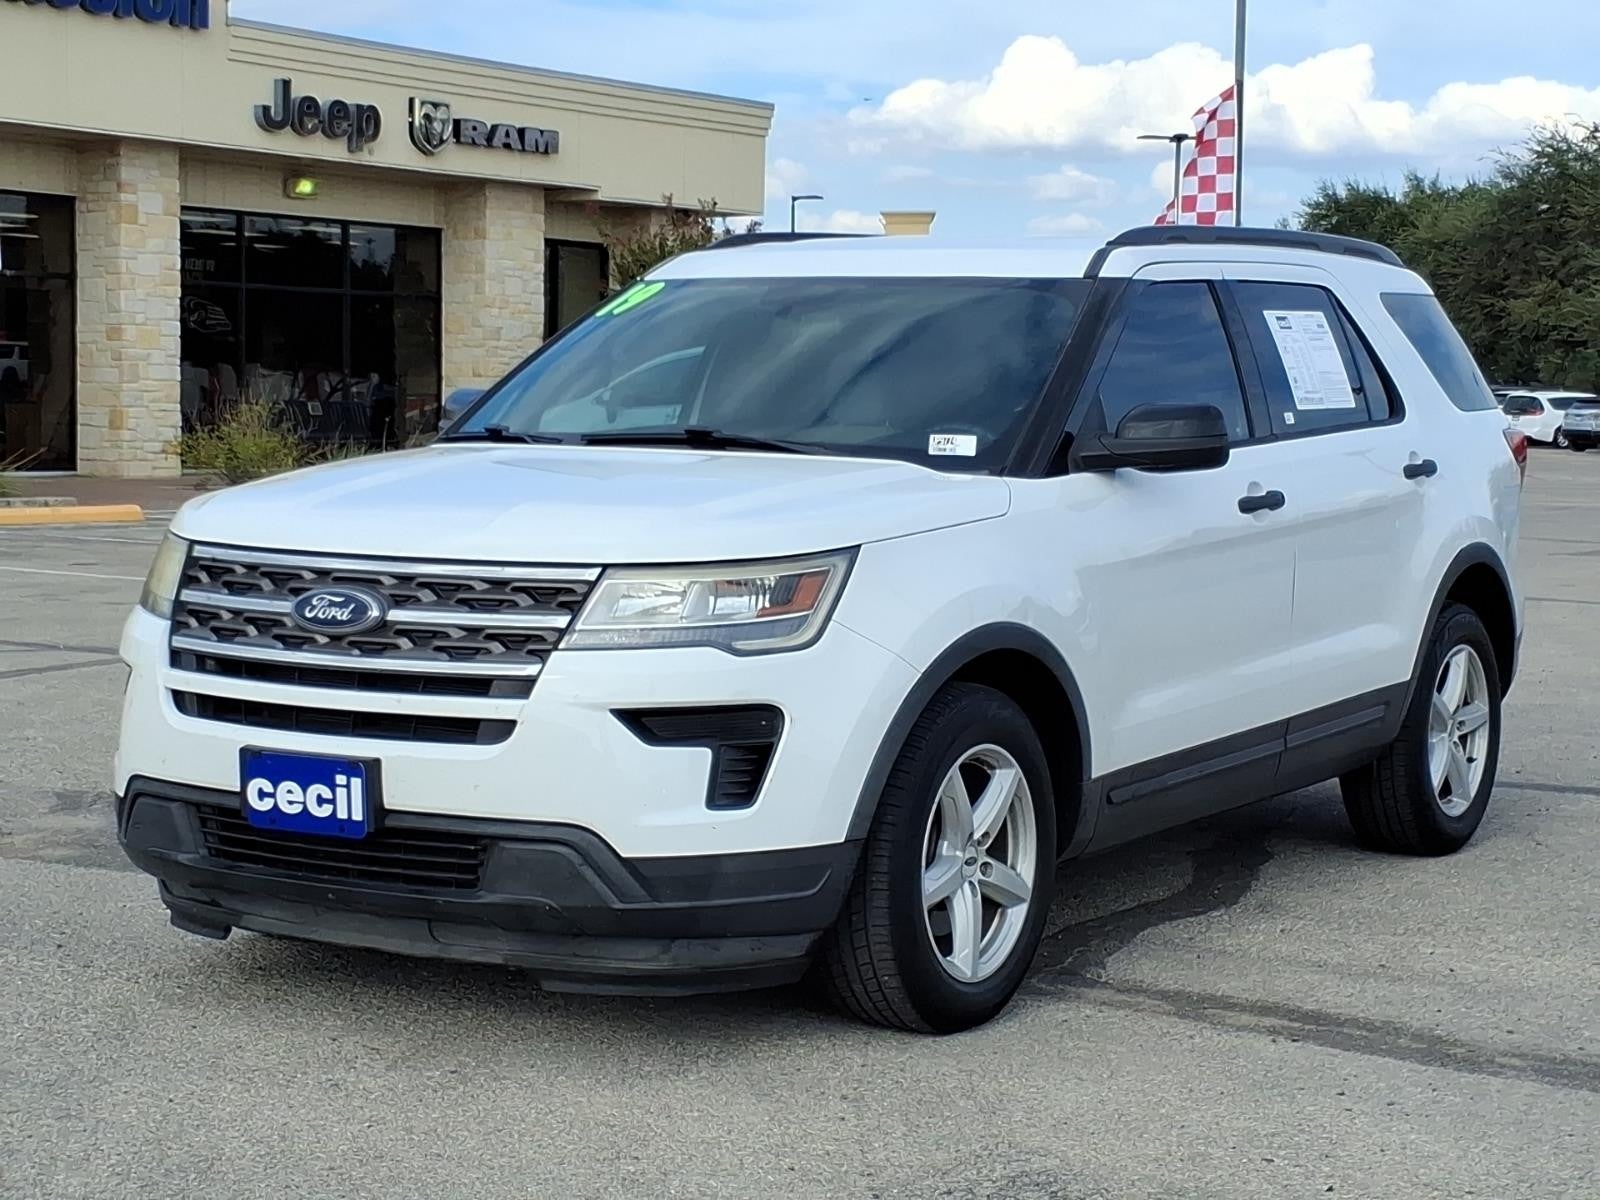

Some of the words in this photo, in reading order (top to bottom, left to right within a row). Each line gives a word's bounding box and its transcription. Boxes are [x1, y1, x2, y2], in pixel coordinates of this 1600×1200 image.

[254, 78, 382, 153] Jeep
[453, 118, 559, 154] RAM
[304, 594, 356, 621] Ford
[246, 774, 363, 822] cecil
